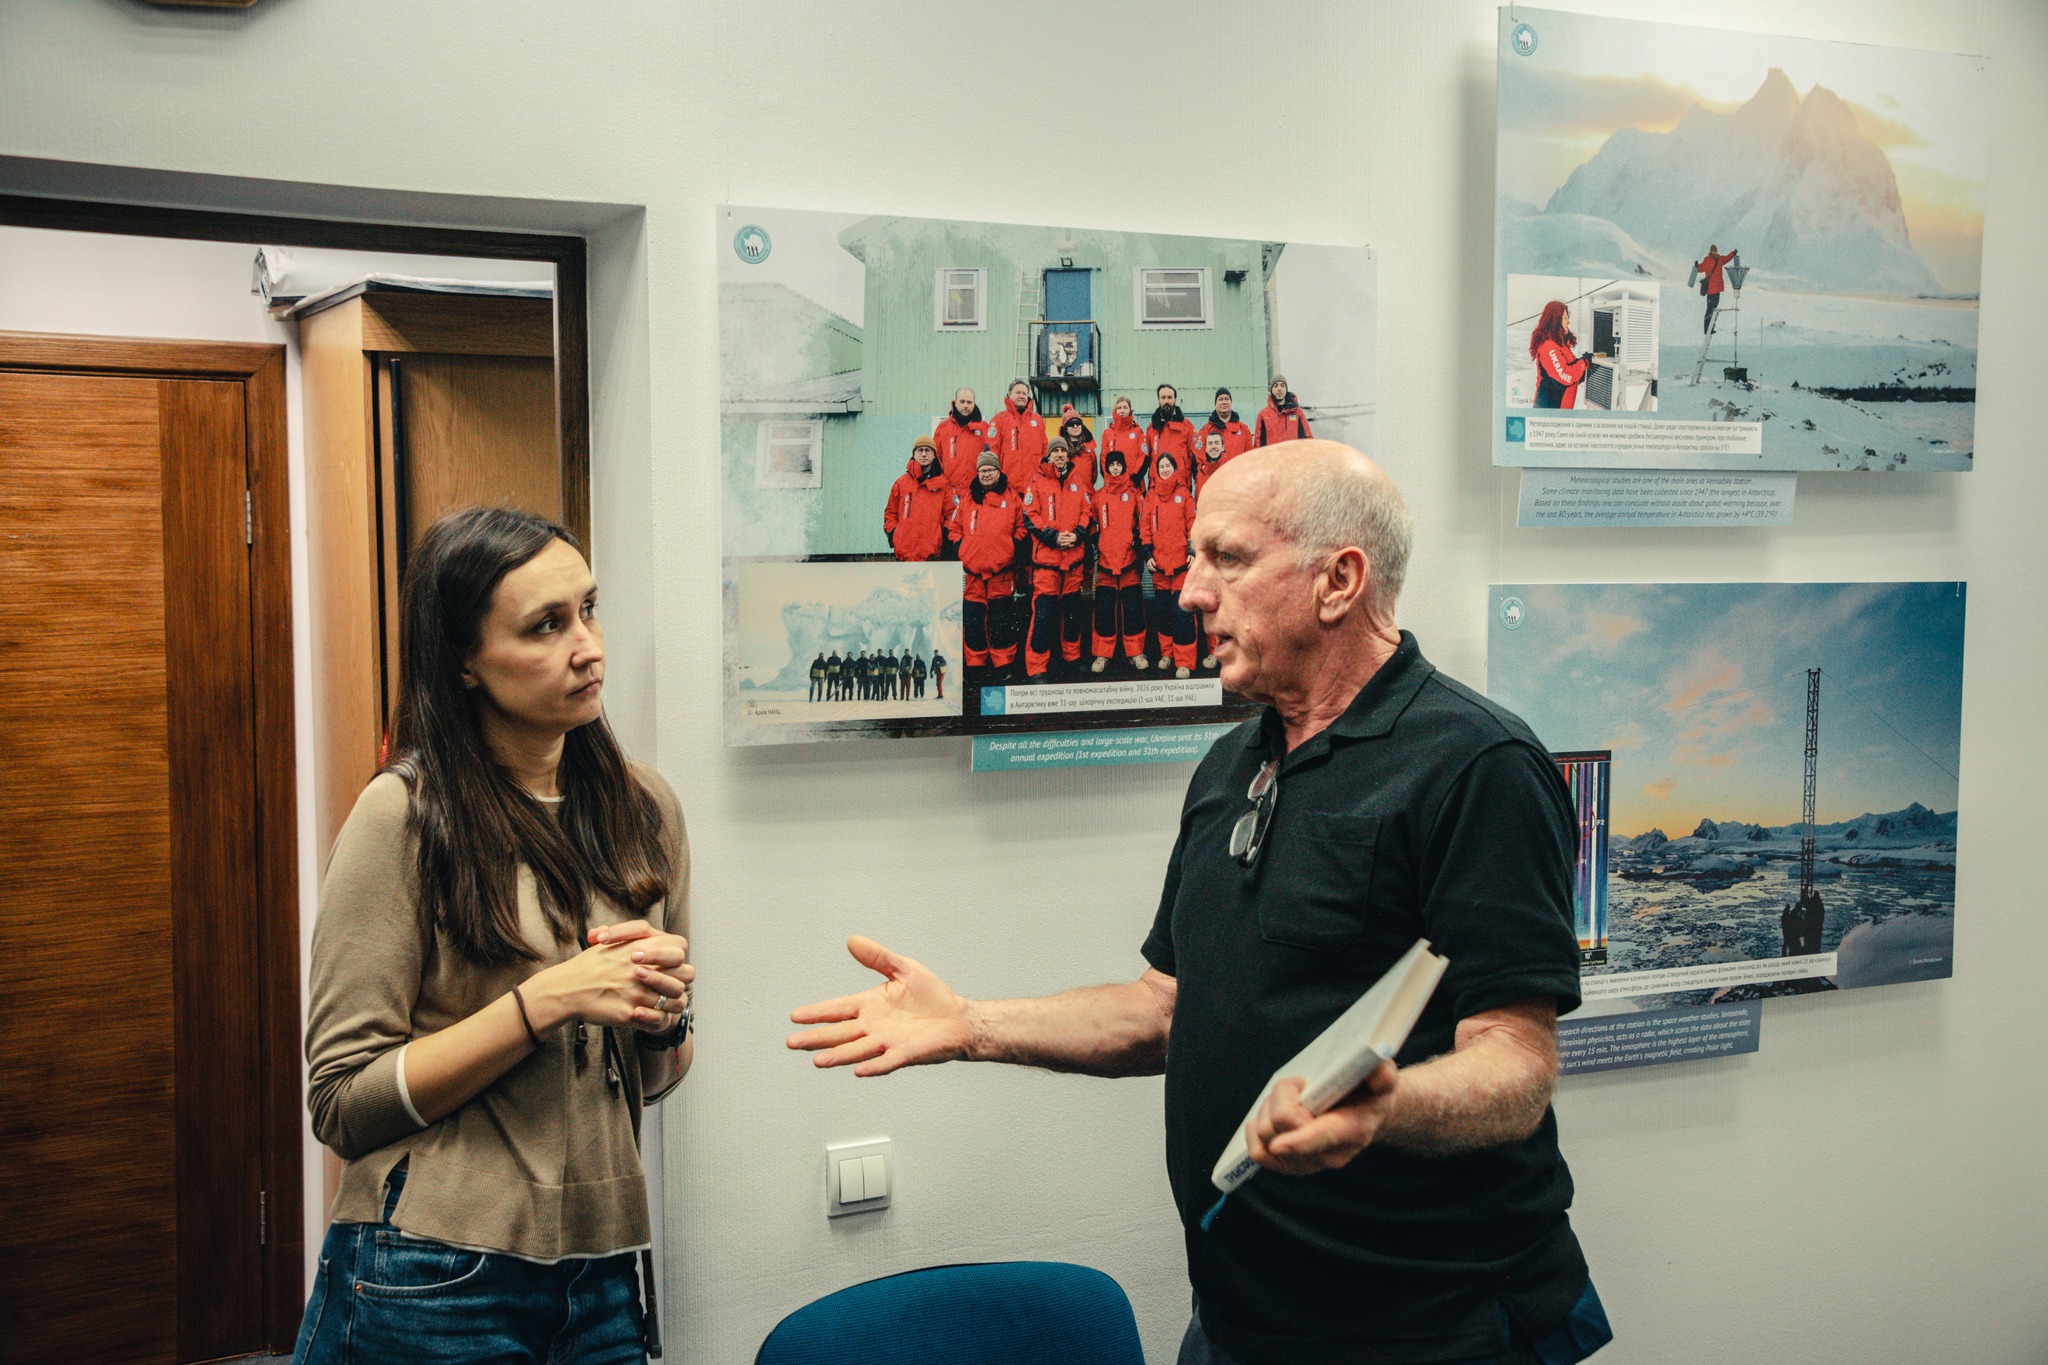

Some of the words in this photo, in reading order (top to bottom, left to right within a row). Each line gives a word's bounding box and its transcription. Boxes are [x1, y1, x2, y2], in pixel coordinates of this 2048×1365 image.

[1549, 350, 1572, 383] UKRAINE
[1570, 476, 1610, 485] Meteorological
[1654, 477, 1660, 485] of
[1706, 477, 1732, 486] Vernadsky
[1581, 488, 1611, 496] monitoring
[1695, 488, 1709, 496] 1947
[1721, 488, 1740, 497] longest
[1741, 488, 1746, 496] in
[1534, 499, 1551, 507] Based
[1561, 499, 1576, 507] these
[1625, 499, 1649, 507] conclude
[1650, 499, 1671, 507] without
[1672, 499, 1687, 507] doubt
[1688, 499, 1704, 507] about
[1705, 499, 1721, 508] global
[1723, 499, 1745, 508] warming
[1617, 510, 1637, 518] annual
[1637, 510, 1670, 519] temperature
[1672, 510, 1676, 518] in
[1677, 510, 1705, 518] Antarctica
[1706, 510, 1715, 518] has
[1734, 510, 1740, 519] by
[1010, 689, 1028, 698] Попри
[1039, 688, 1064, 697] труднощі
[1073, 686, 1118, 695] повномасштабну
[1164, 683, 1184, 692] Україна
[1185, 682, 1214, 691] відправила
[1015, 700, 1046, 709] Антарктику
[1060, 699, 1077, 708] 31-шу
[1079, 698, 1105, 707] цілорічну
[1106, 697, 1137, 706] експедицію
[1138, 696, 1153, 705] (1-ша
[1185, 694, 1197, 703] УАЕ)
[989, 741, 1016, 752] Despite
[1018, 740, 1027, 749] all
[1029, 740, 1041, 749] the
[1043, 738, 1078, 749] difficulties
[1081, 737, 1094, 746] and
[1096, 735, 1132, 747] large-scale
[1151, 733, 1176, 742] Ukraine
[1178, 732, 1192, 741] sent
[1203, 731, 1219, 740] 31th
[1010, 753, 1035, 762] annual
[1037, 751, 1074, 762] expedition
[1076, 750, 1089, 760] (1st
[1091, 749, 1126, 759] expedition
[1128, 748, 1141, 756] and
[1143, 747, 1159, 756] 31th
[1581, 1024, 1608, 1034] directions
[1609, 1023, 1615, 1031] at
[1616, 1022, 1625, 1030] the
[1626, 1020, 1645, 1029] station
[1646, 1019, 1651, 1027] is
[1652, 1018, 1661, 1026] the
[1678, 1014, 1699, 1023] weather
[1559, 1037, 1586, 1047] Ukrainian
[1616, 1032, 1627, 1040] acts
[1658, 1027, 1674, 1036] which
[1690, 1024, 1699, 1032] the
[1700, 1023, 1712, 1031] data
[1713, 1021, 1728, 1030] about
[1729, 1020, 1738, 1028] the
[1738, 1019, 1751, 1027] state
[1571, 1049, 1586, 1058] every
[1587, 1047, 1595, 1055] 15
[1610, 1044, 1620, 1052] The
[1621, 1041, 1651, 1052] ionosphere
[1652, 1040, 1656, 1048] is
[1657, 1039, 1667, 1047] the
[1668, 1036, 1687, 1047] highest
[1688, 1035, 1701, 1045] layer
[1702, 1034, 1708, 1043] of
[1709, 1033, 1717, 1041] the
[1566, 1059, 1581, 1068] sun's
[1582, 1057, 1596, 1066] wind
[1597, 1056, 1613, 1064] meets
[1614, 1054, 1623, 1062] the
[1624, 1052, 1643, 1061] Earth's
[1644, 1049, 1669, 1060] magnetic
[1683, 1045, 1705, 1055] creating
[1706, 1043, 1719, 1052] Polar
